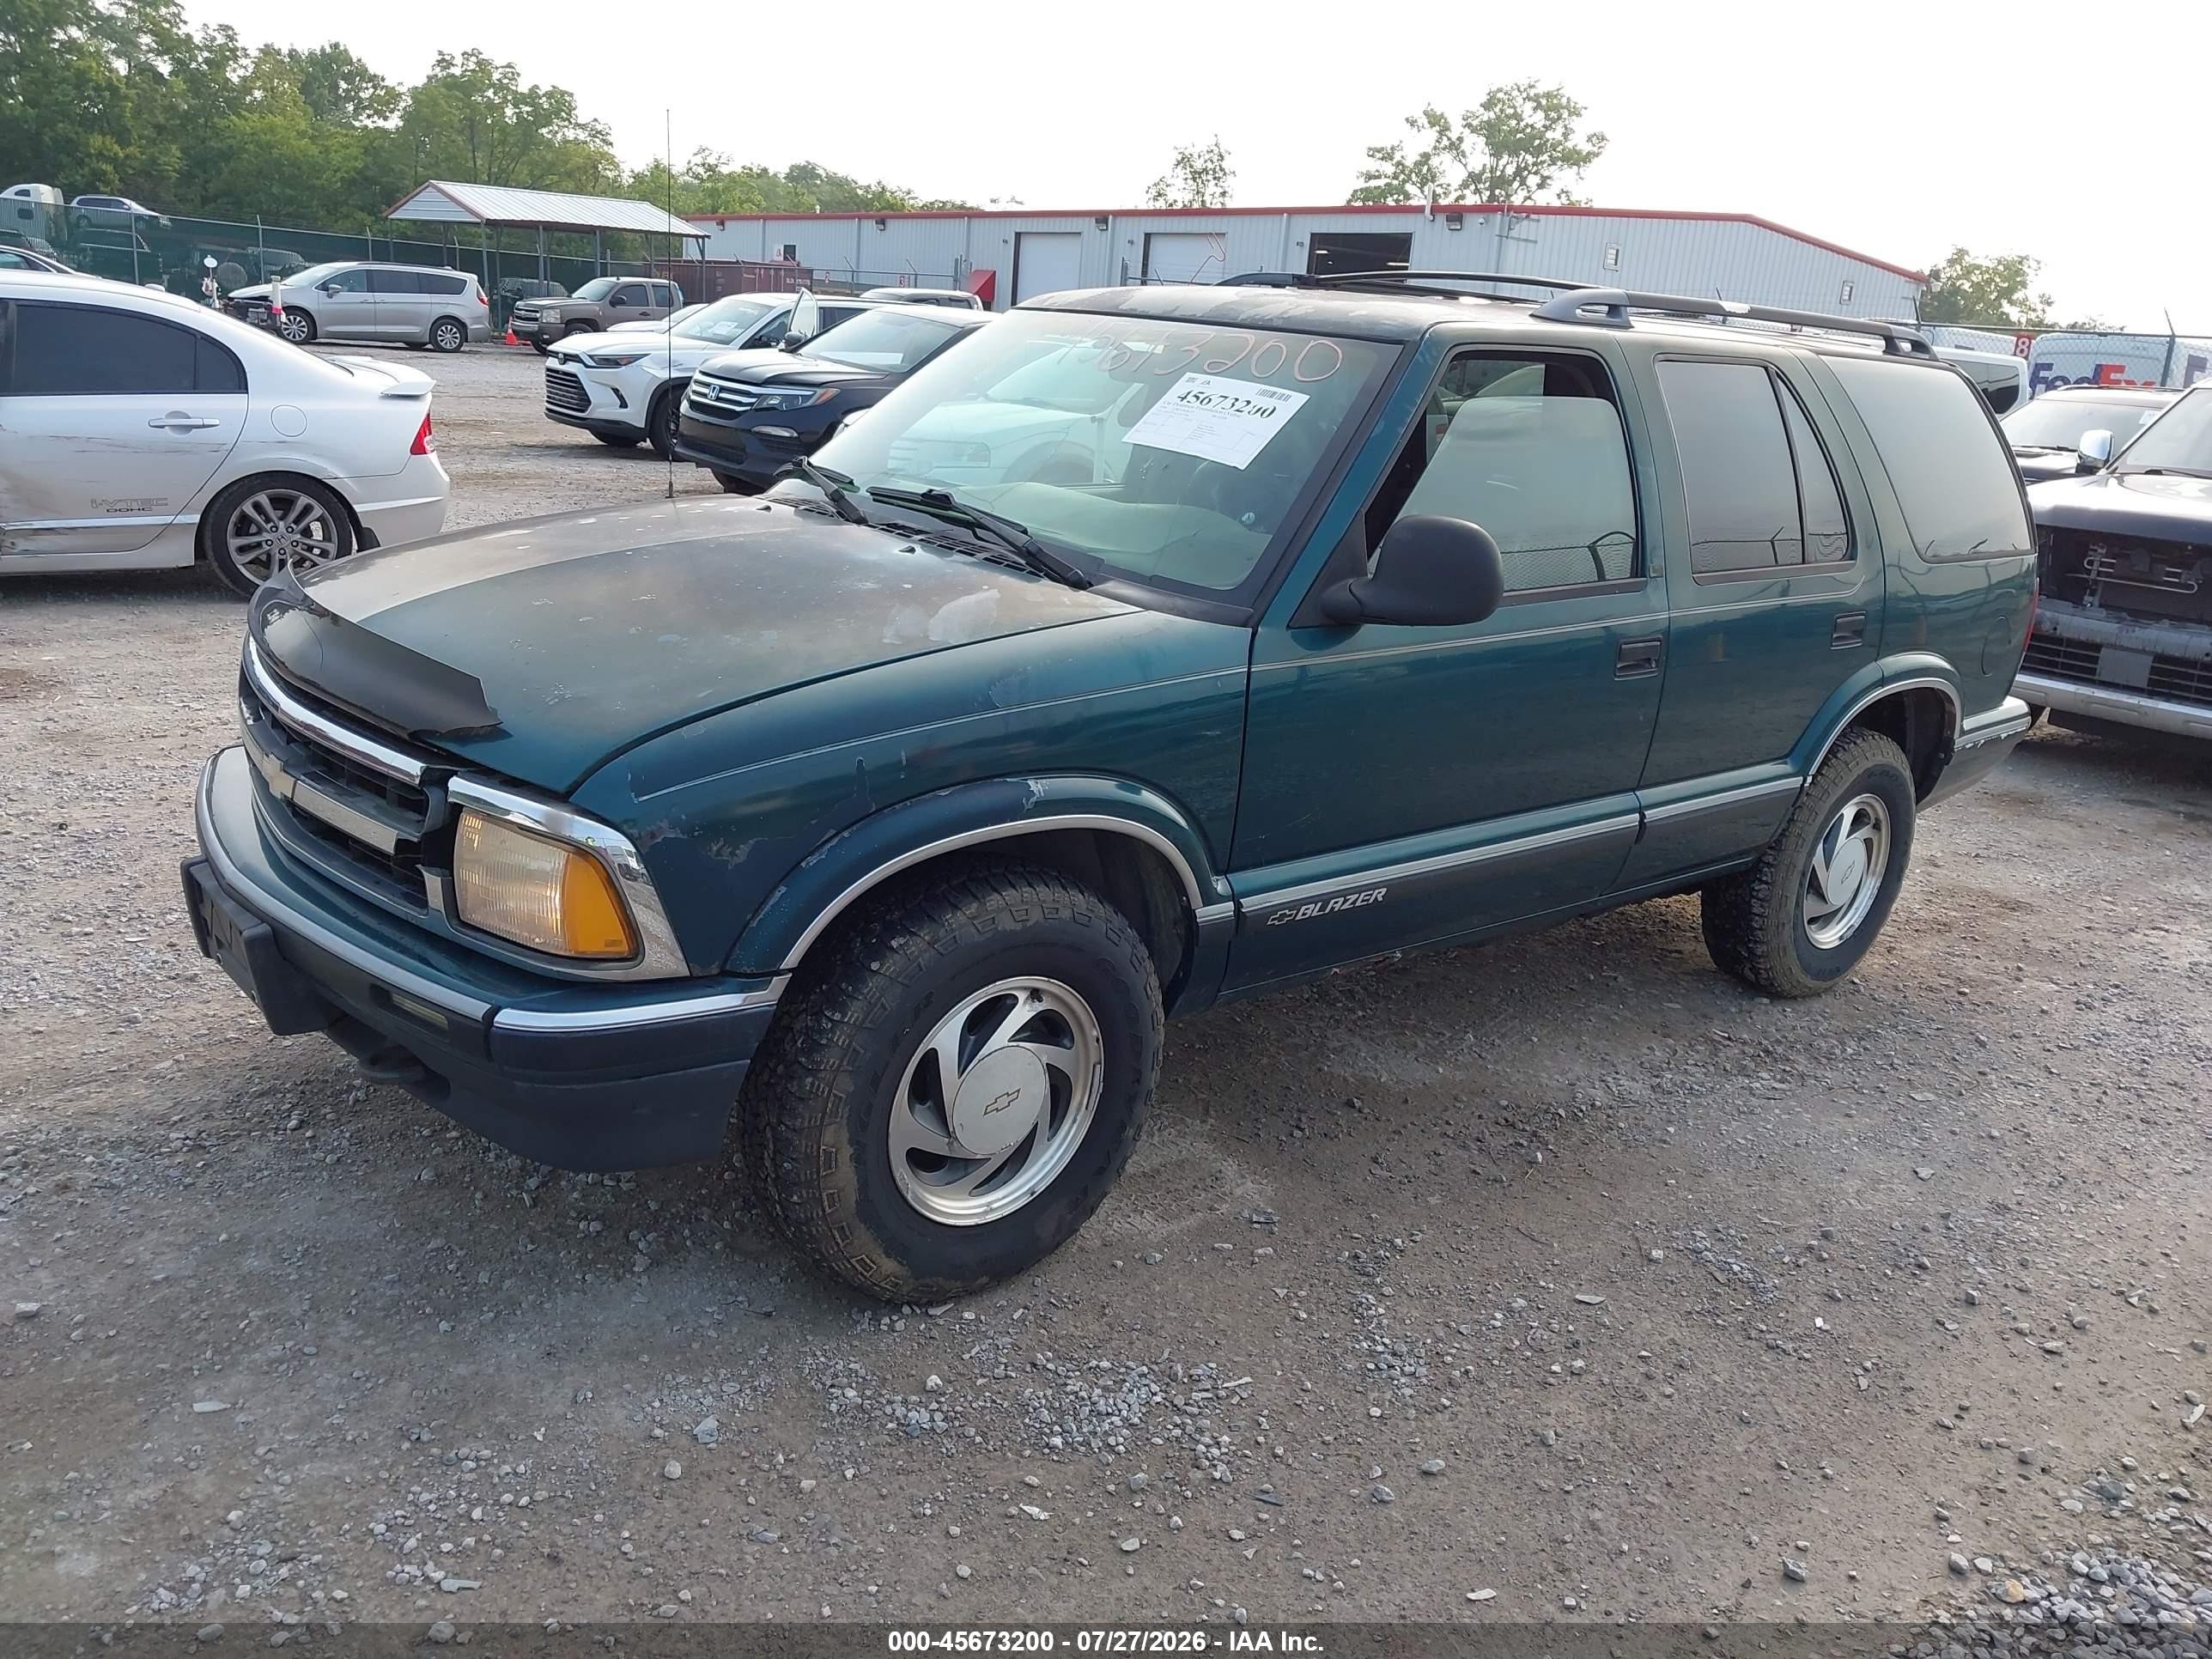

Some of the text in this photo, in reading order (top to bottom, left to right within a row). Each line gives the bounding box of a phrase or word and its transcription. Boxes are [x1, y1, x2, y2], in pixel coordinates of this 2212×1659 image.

[2015, 337, 2030, 358] 8
[1176, 389, 1278, 420] 45673200
[1295, 887, 1388, 921] BLAZER
